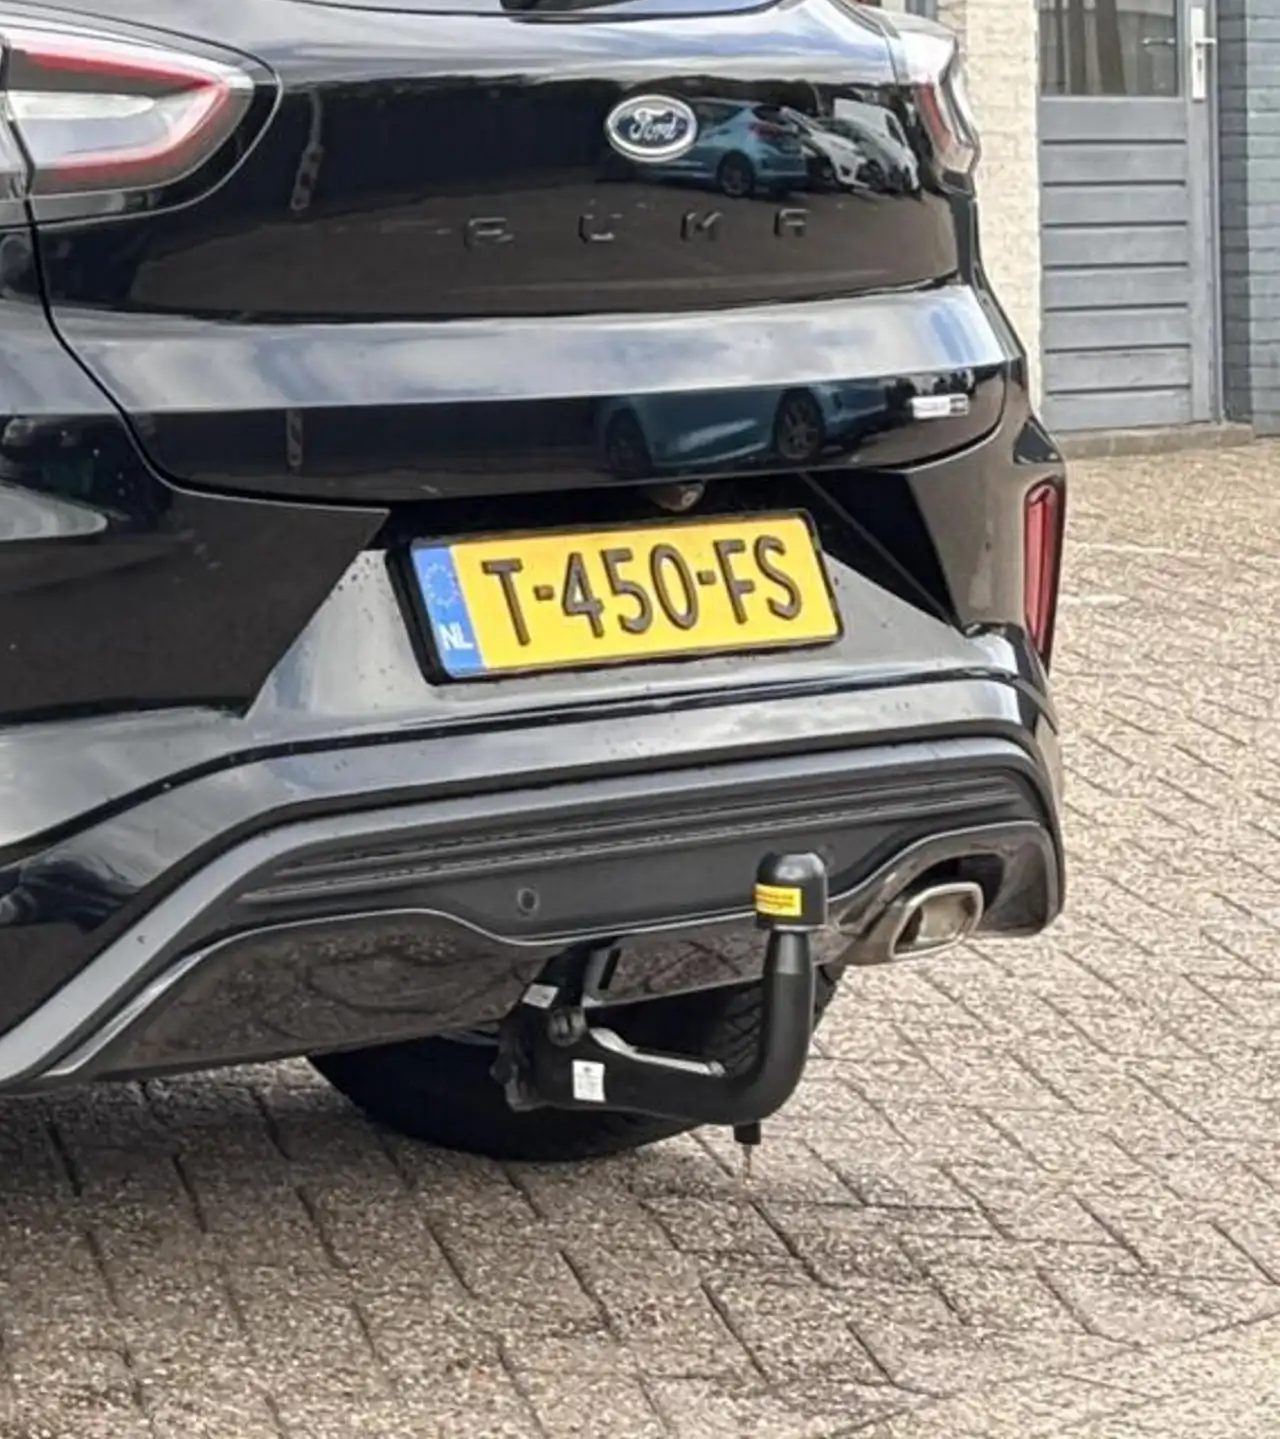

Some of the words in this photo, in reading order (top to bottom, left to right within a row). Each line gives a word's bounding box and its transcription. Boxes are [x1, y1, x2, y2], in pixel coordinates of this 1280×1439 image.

[463, 206, 812, 250] PUMA
[481, 535, 803, 647] T-450-FS
[439, 624, 474, 651] NL
